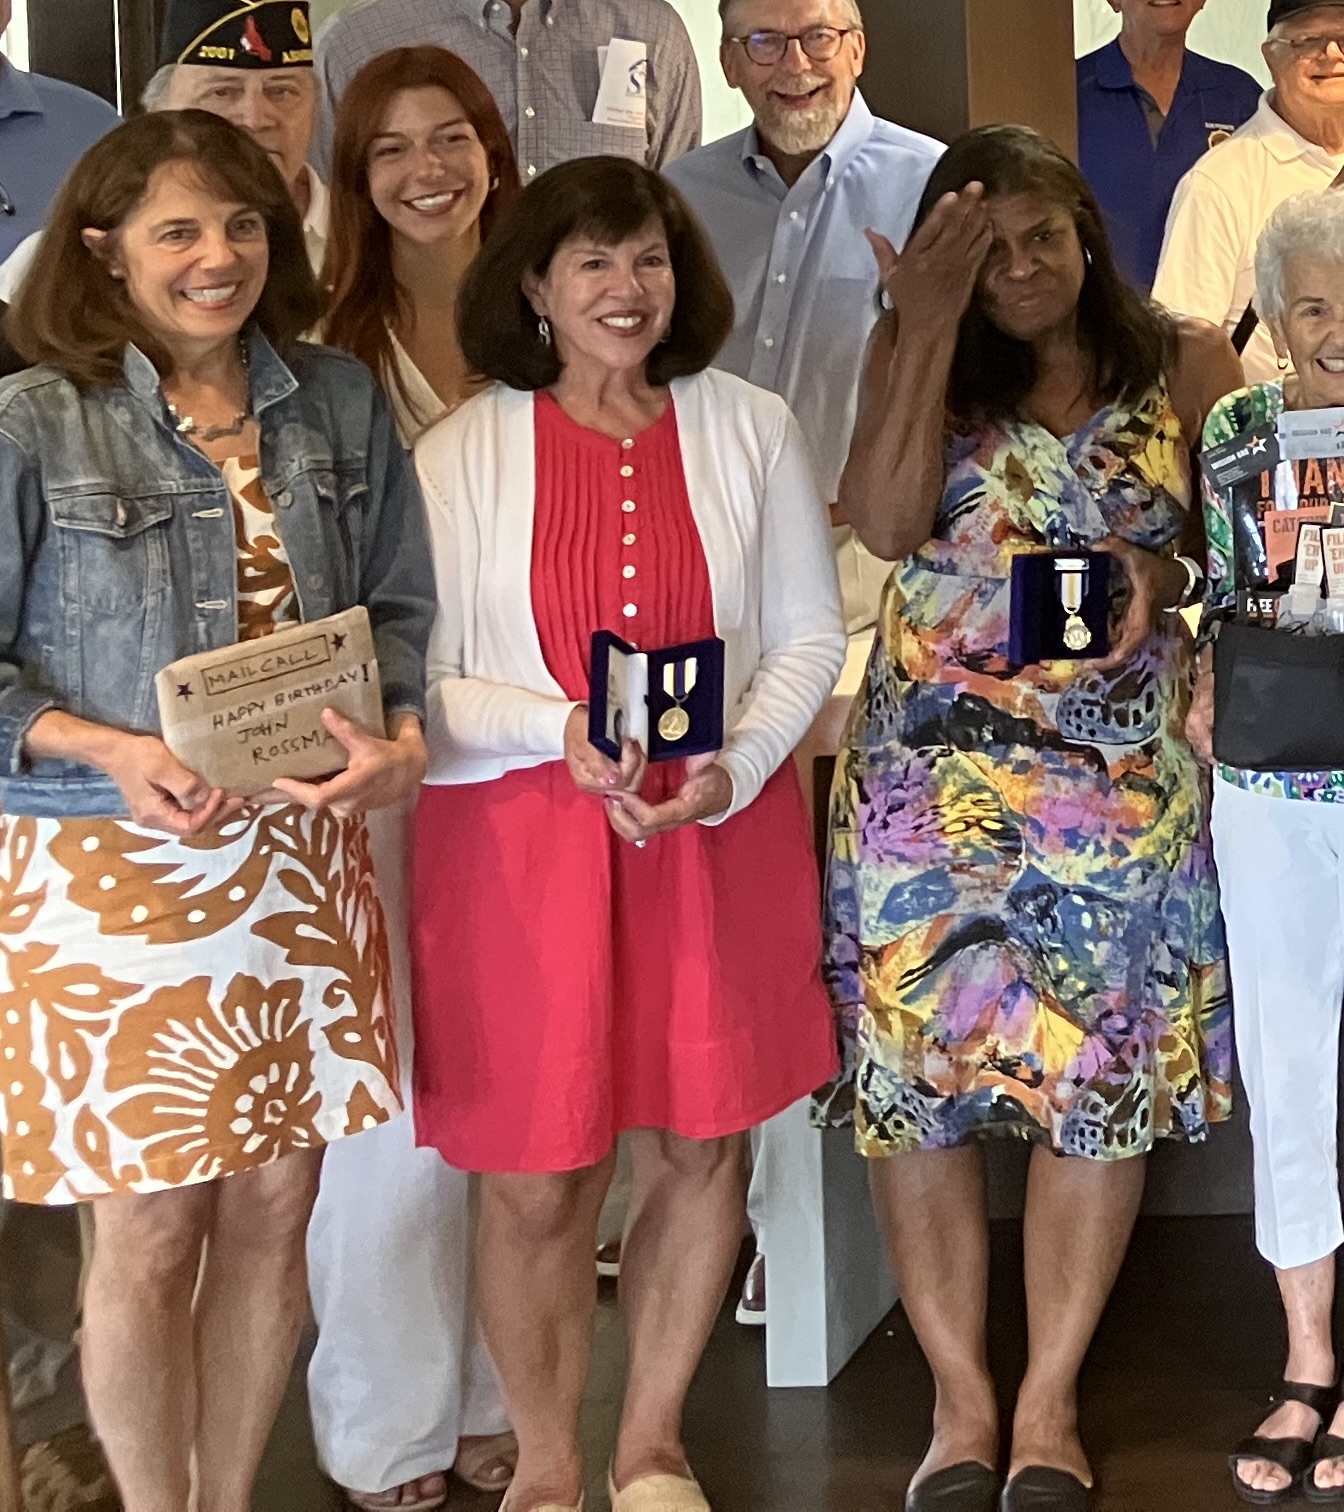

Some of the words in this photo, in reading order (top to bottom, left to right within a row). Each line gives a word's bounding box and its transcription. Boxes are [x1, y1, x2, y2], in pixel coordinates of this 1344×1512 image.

[199, 45, 235, 60] 2001
[1304, 559, 1319, 571] UP
[206, 662, 258, 687] MAIL
[260, 649, 319, 674] CALL
[212, 699, 267, 731] HAPPY
[273, 663, 369, 707] BIRTHDAY!
[236, 712, 289, 745] JOHN
